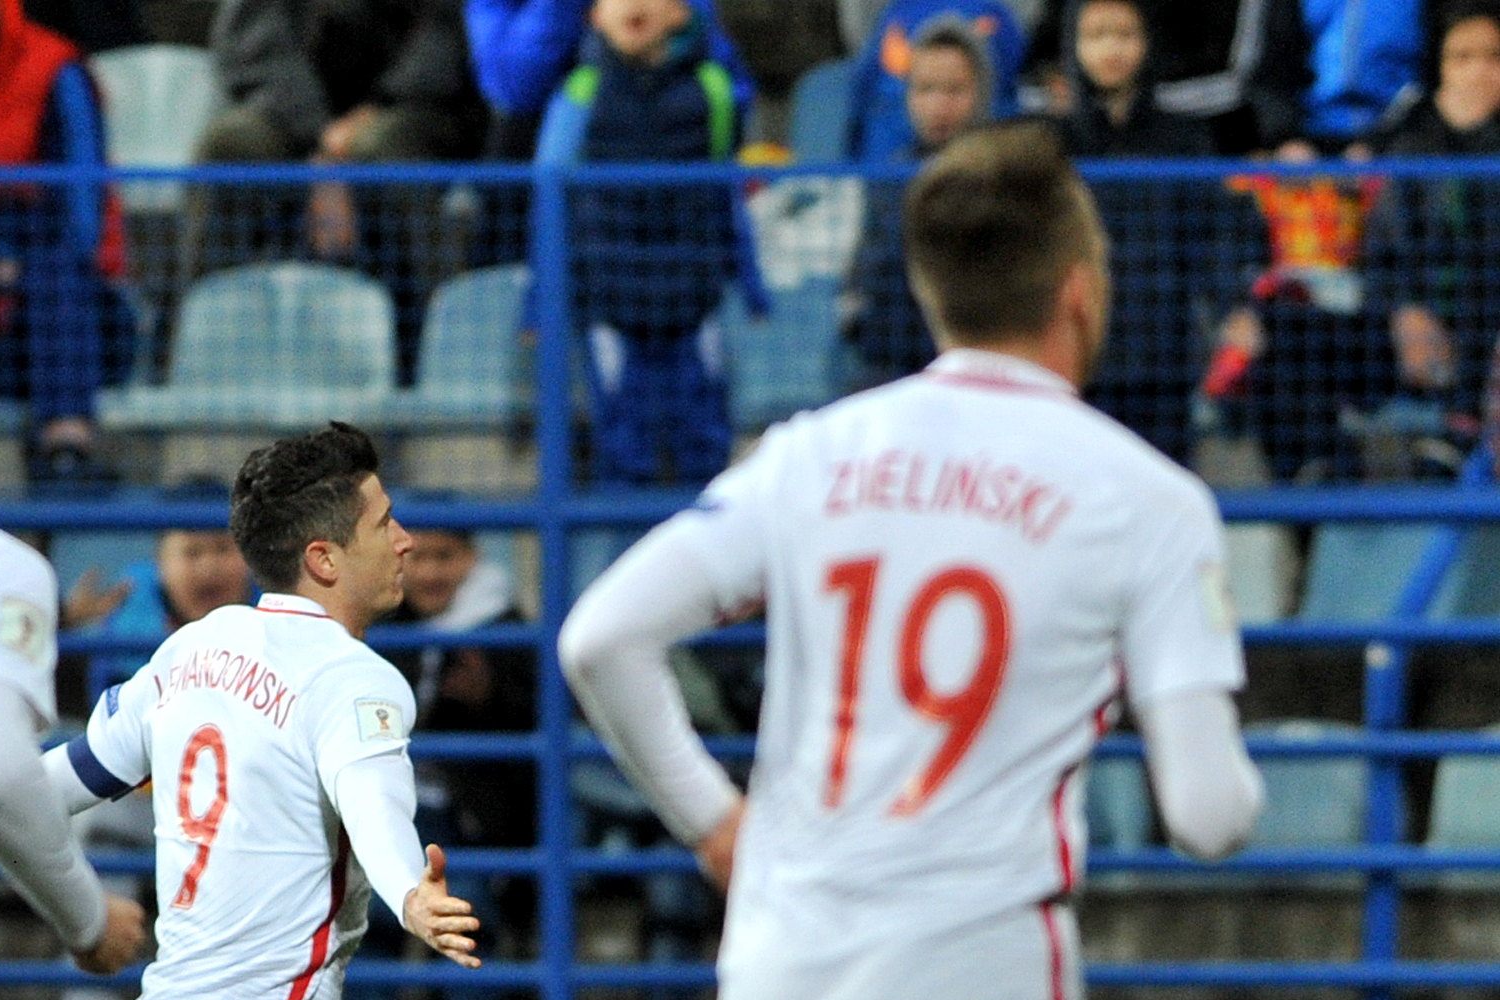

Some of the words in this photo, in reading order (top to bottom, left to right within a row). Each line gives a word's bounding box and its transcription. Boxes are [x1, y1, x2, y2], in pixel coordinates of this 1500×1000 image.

[823, 448, 1076, 542] ZIELIŃSKI
[818, 553, 1011, 818] 19
[170, 722, 228, 910] 9
